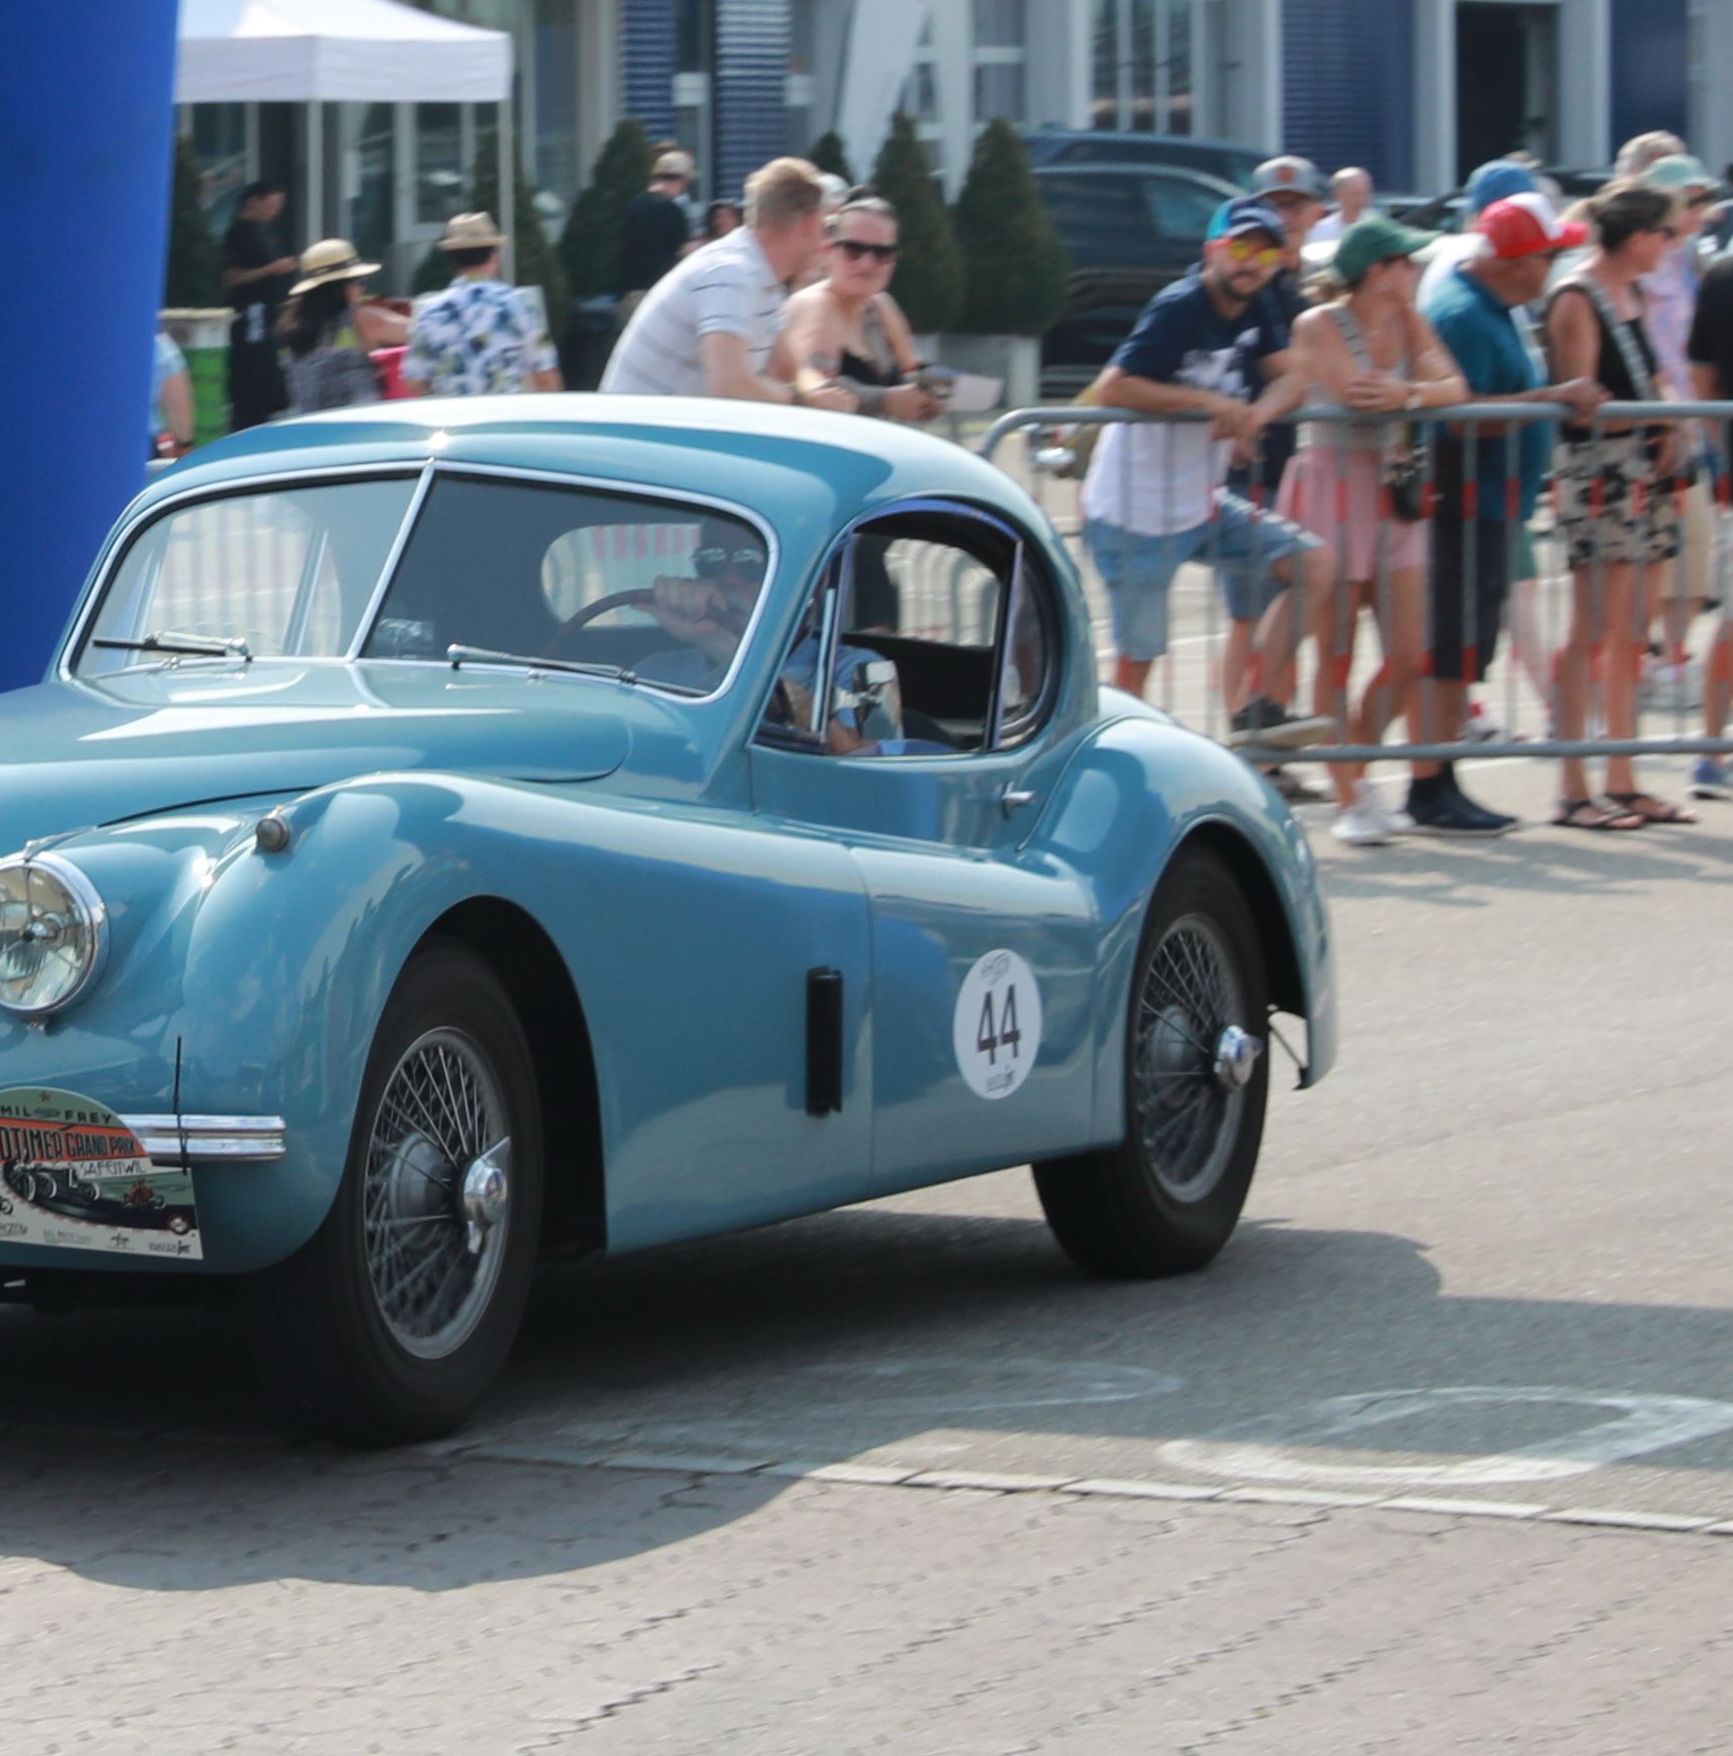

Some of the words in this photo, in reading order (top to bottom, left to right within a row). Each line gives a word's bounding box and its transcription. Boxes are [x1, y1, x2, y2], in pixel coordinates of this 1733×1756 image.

[977, 984, 1021, 1066] 44
[64, 1109, 112, 1125] FREY
[66, 1131, 108, 1158] GRAND
[109, 1136, 137, 1156] PRIX
